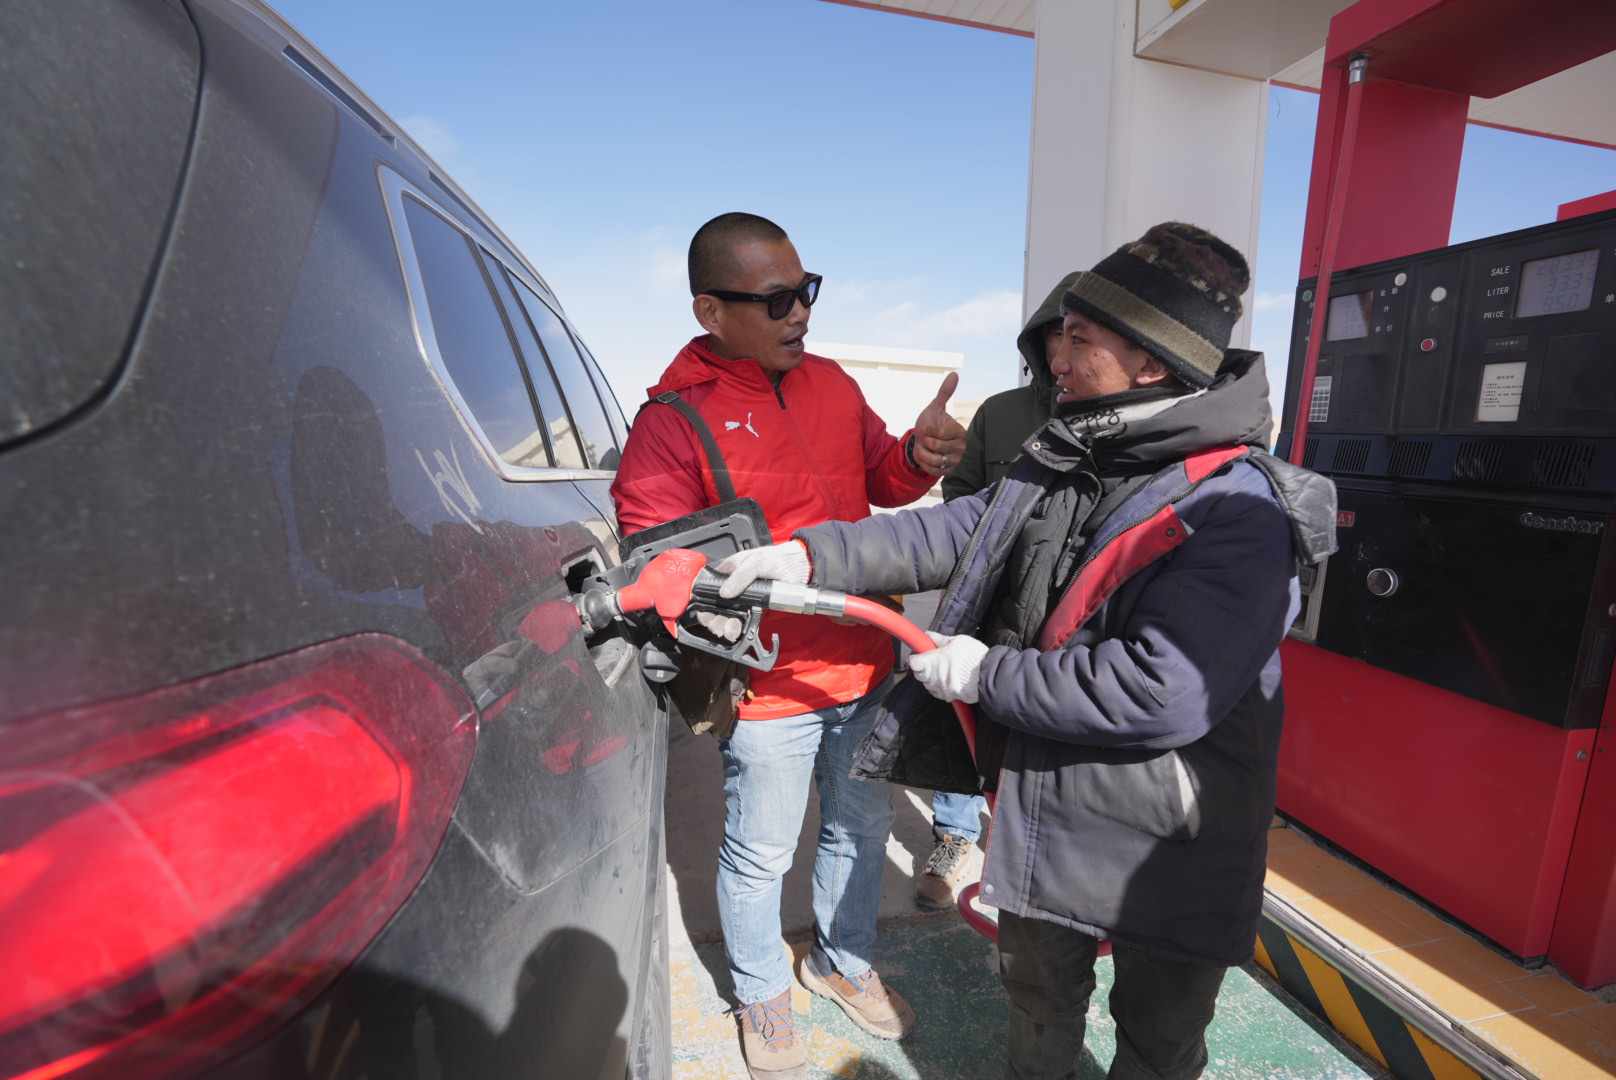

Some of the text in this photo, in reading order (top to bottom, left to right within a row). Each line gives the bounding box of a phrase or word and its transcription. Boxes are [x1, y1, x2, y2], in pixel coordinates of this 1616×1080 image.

[1491, 265, 1511, 276] SALE
[1487, 286, 1510, 297] LITER
[1483, 310, 1505, 320] PRICE
